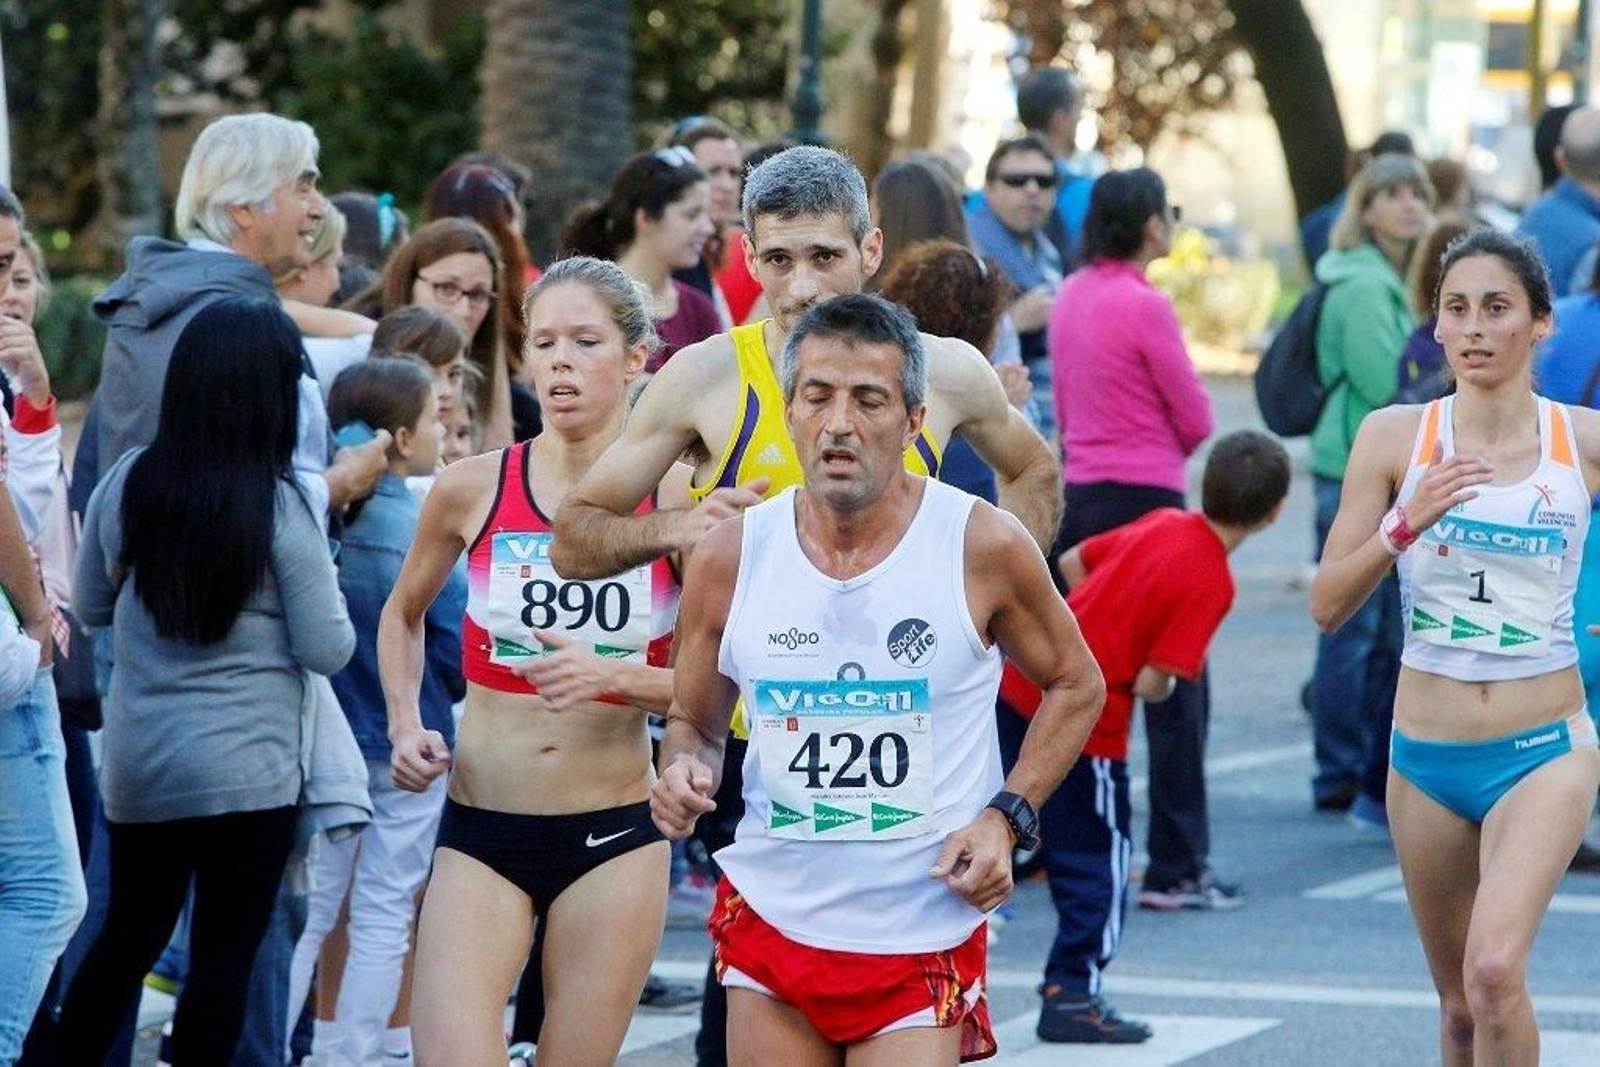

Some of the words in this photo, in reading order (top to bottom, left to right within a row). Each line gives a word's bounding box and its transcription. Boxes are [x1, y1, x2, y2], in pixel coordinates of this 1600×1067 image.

[1469, 570, 1493, 604] 1
[521, 579, 630, 632] 890
[889, 624, 920, 657] Sport
[905, 633, 935, 665] Life
[1514, 729, 1560, 750] hummel
[788, 732, 910, 789] 420
